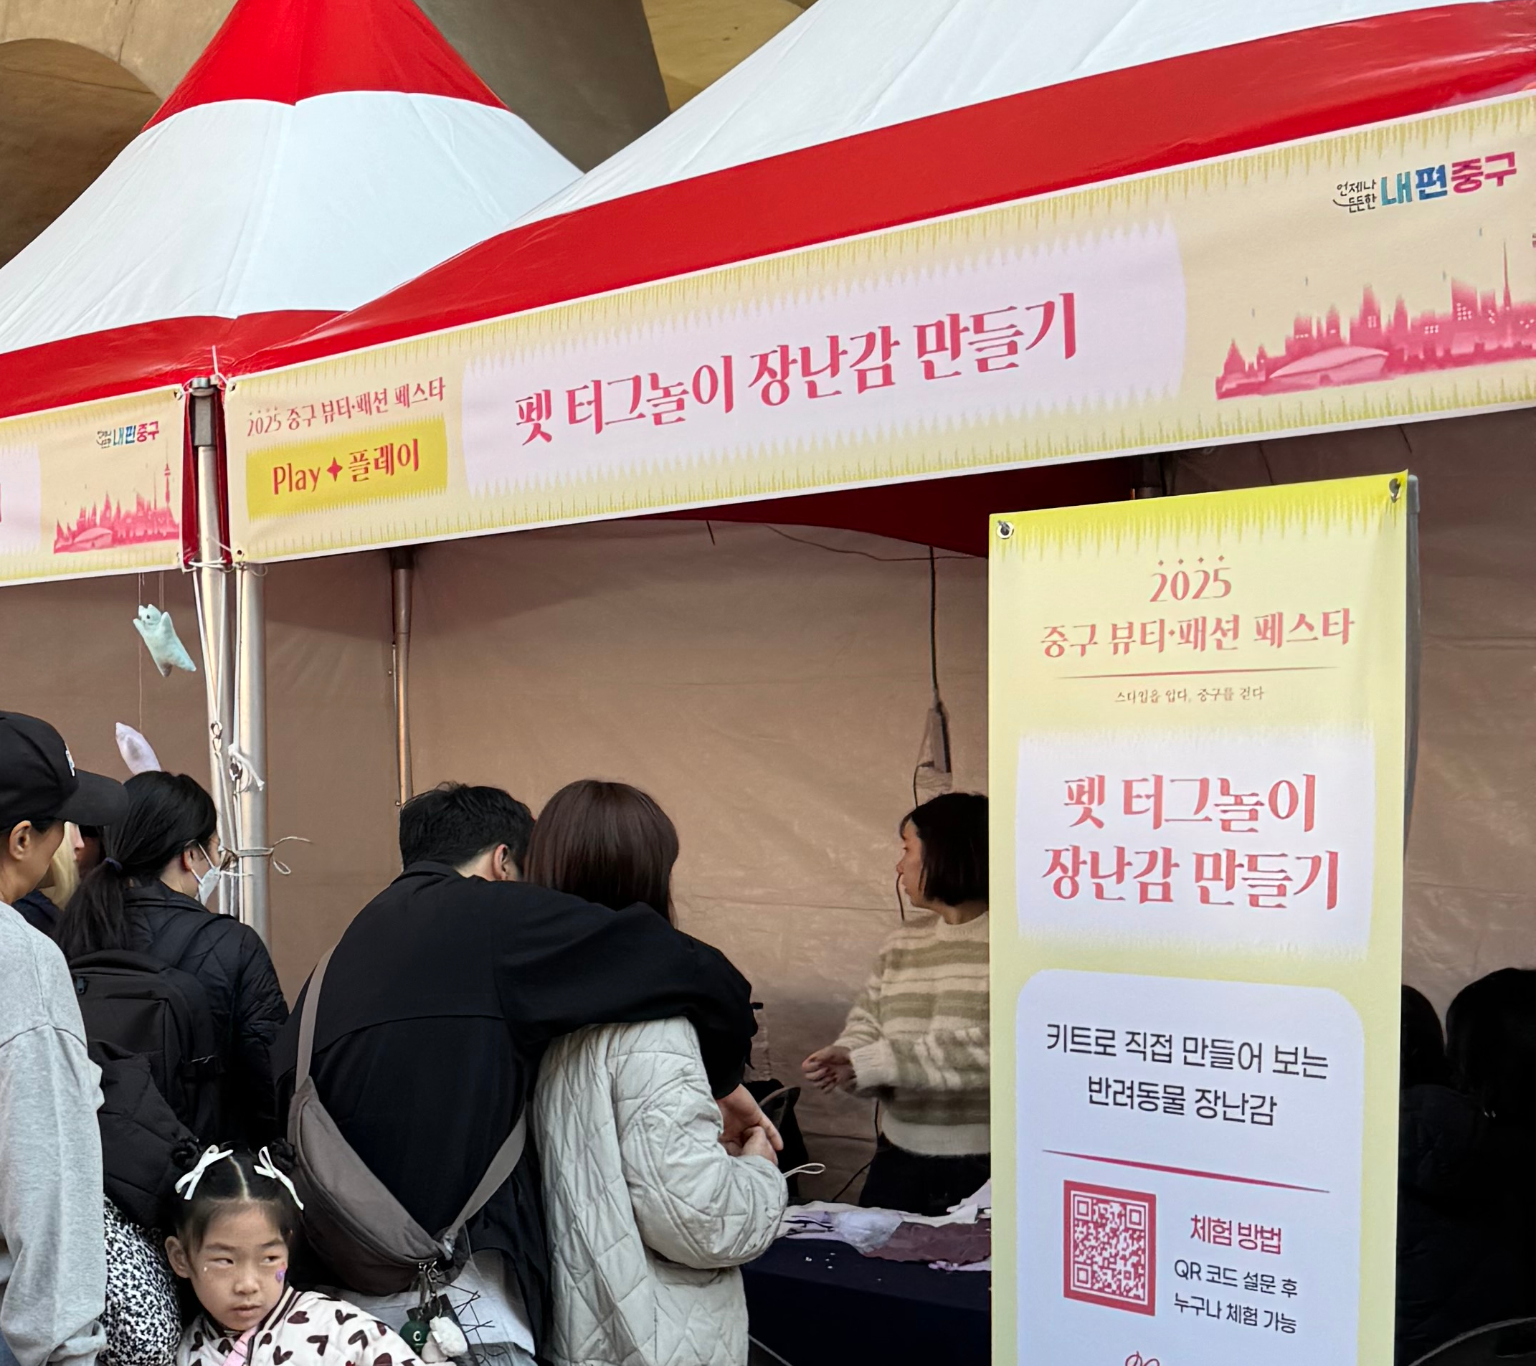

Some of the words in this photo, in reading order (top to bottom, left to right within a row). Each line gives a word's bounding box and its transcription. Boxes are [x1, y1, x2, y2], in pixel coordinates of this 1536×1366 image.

[514, 388, 553, 446] 펫
[567, 355, 735, 436] 터그놀이
[747, 325, 900, 407] 장난감
[913, 292, 1078, 379] 만들기
[246, 411, 282, 437] 2025
[286, 405, 317, 431] 중구
[394, 376, 446, 409] 페스타
[272, 463, 321, 495] Play
[348, 438, 420, 483] 플레이
[1149, 566, 1233, 603] 2025
[1040, 623, 1099, 659] 중구
[1253, 607, 1356, 650] 페스타
[1063, 774, 1106, 830] 펫
[1121, 773, 1317, 834] 터그놀이
[1041, 844, 1180, 905] 장난감
[1192, 847, 1340, 912] 만들기
[1046, 1023, 1117, 1058] 키트로
[1125, 1029, 1174, 1064] 직접
[1182, 1036, 1263, 1074] 만들어
[1272, 1045, 1330, 1080] 보는
[1087, 1075, 1187, 1116] 반려동물
[1194, 1088, 1278, 1127] 장난감
[1189, 1214, 1234, 1247] 체험
[1237, 1221, 1283, 1256] 방법
[1173, 1259, 1203, 1283] QR
[1206, 1265, 1239, 1288] 코드
[1242, 1270, 1277, 1295] 설문
[1280, 1277, 1299, 1298] 후
[1173, 1293, 1223, 1320] 누구나
[1225, 1302, 1259, 1327] 체험
[1262, 1308, 1298, 1335] 가능
